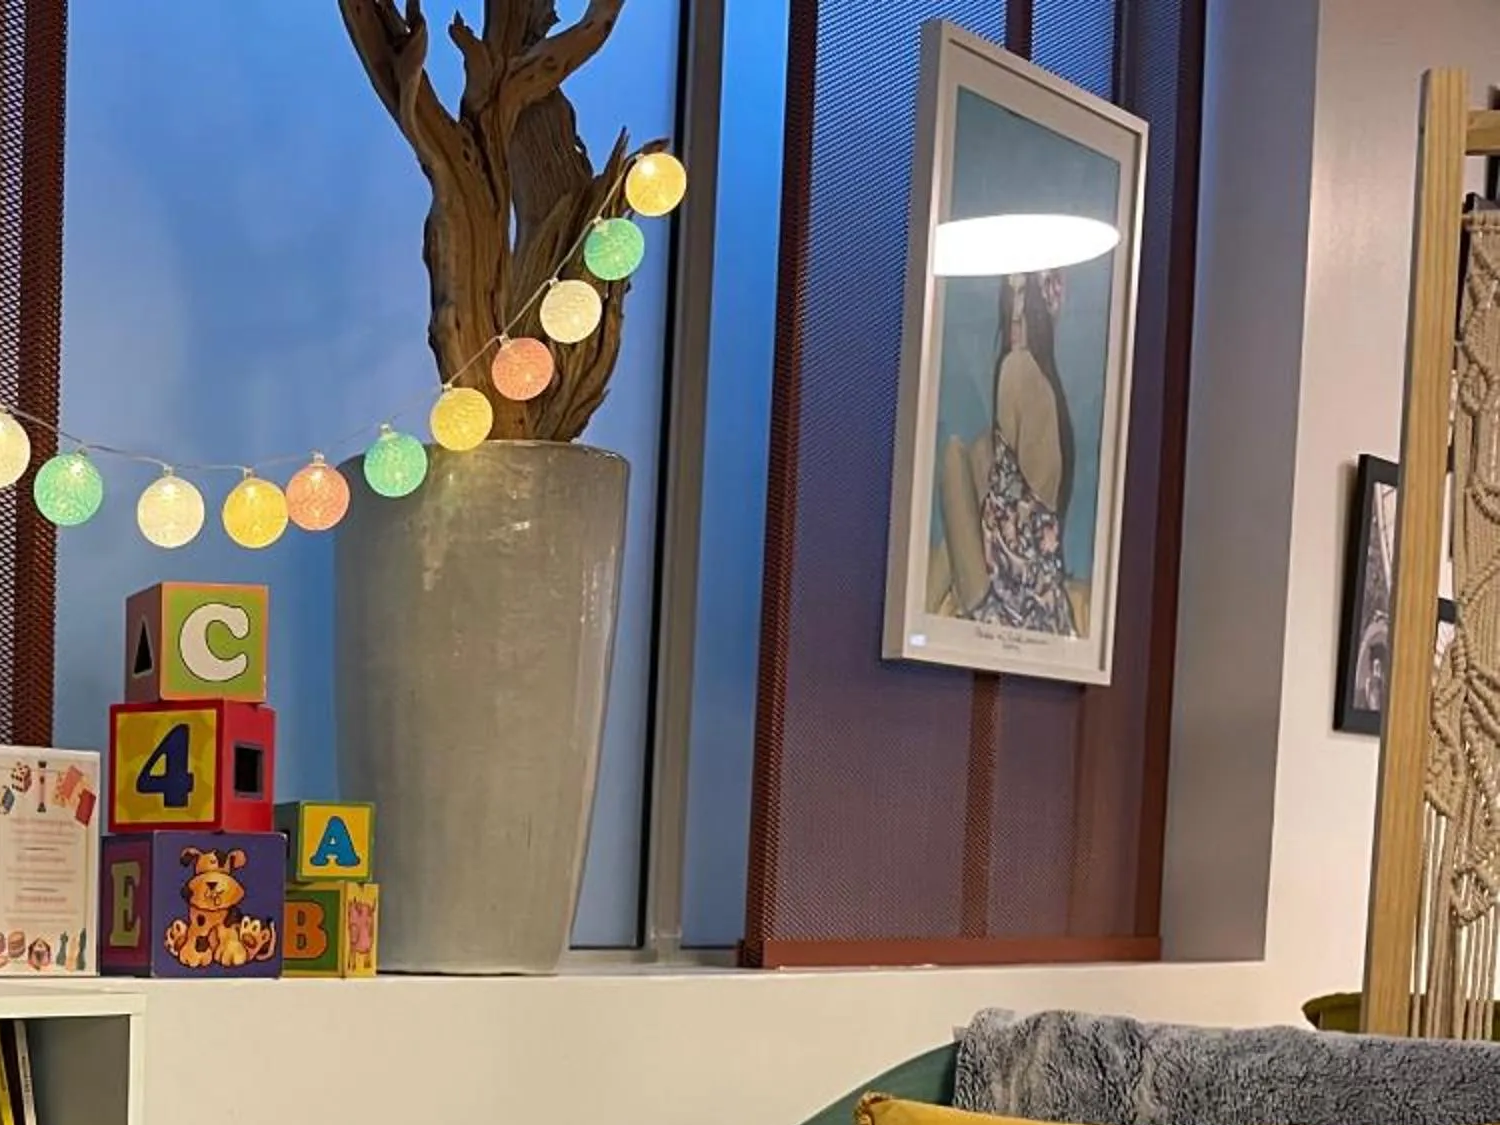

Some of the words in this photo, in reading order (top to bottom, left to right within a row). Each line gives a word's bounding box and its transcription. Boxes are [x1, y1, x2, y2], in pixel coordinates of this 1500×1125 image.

[178, 602, 250, 682] C
[136, 722, 194, 808] 4
[309, 815, 361, 867] A
[109, 861, 141, 948] E
[284, 899, 328, 959] B
